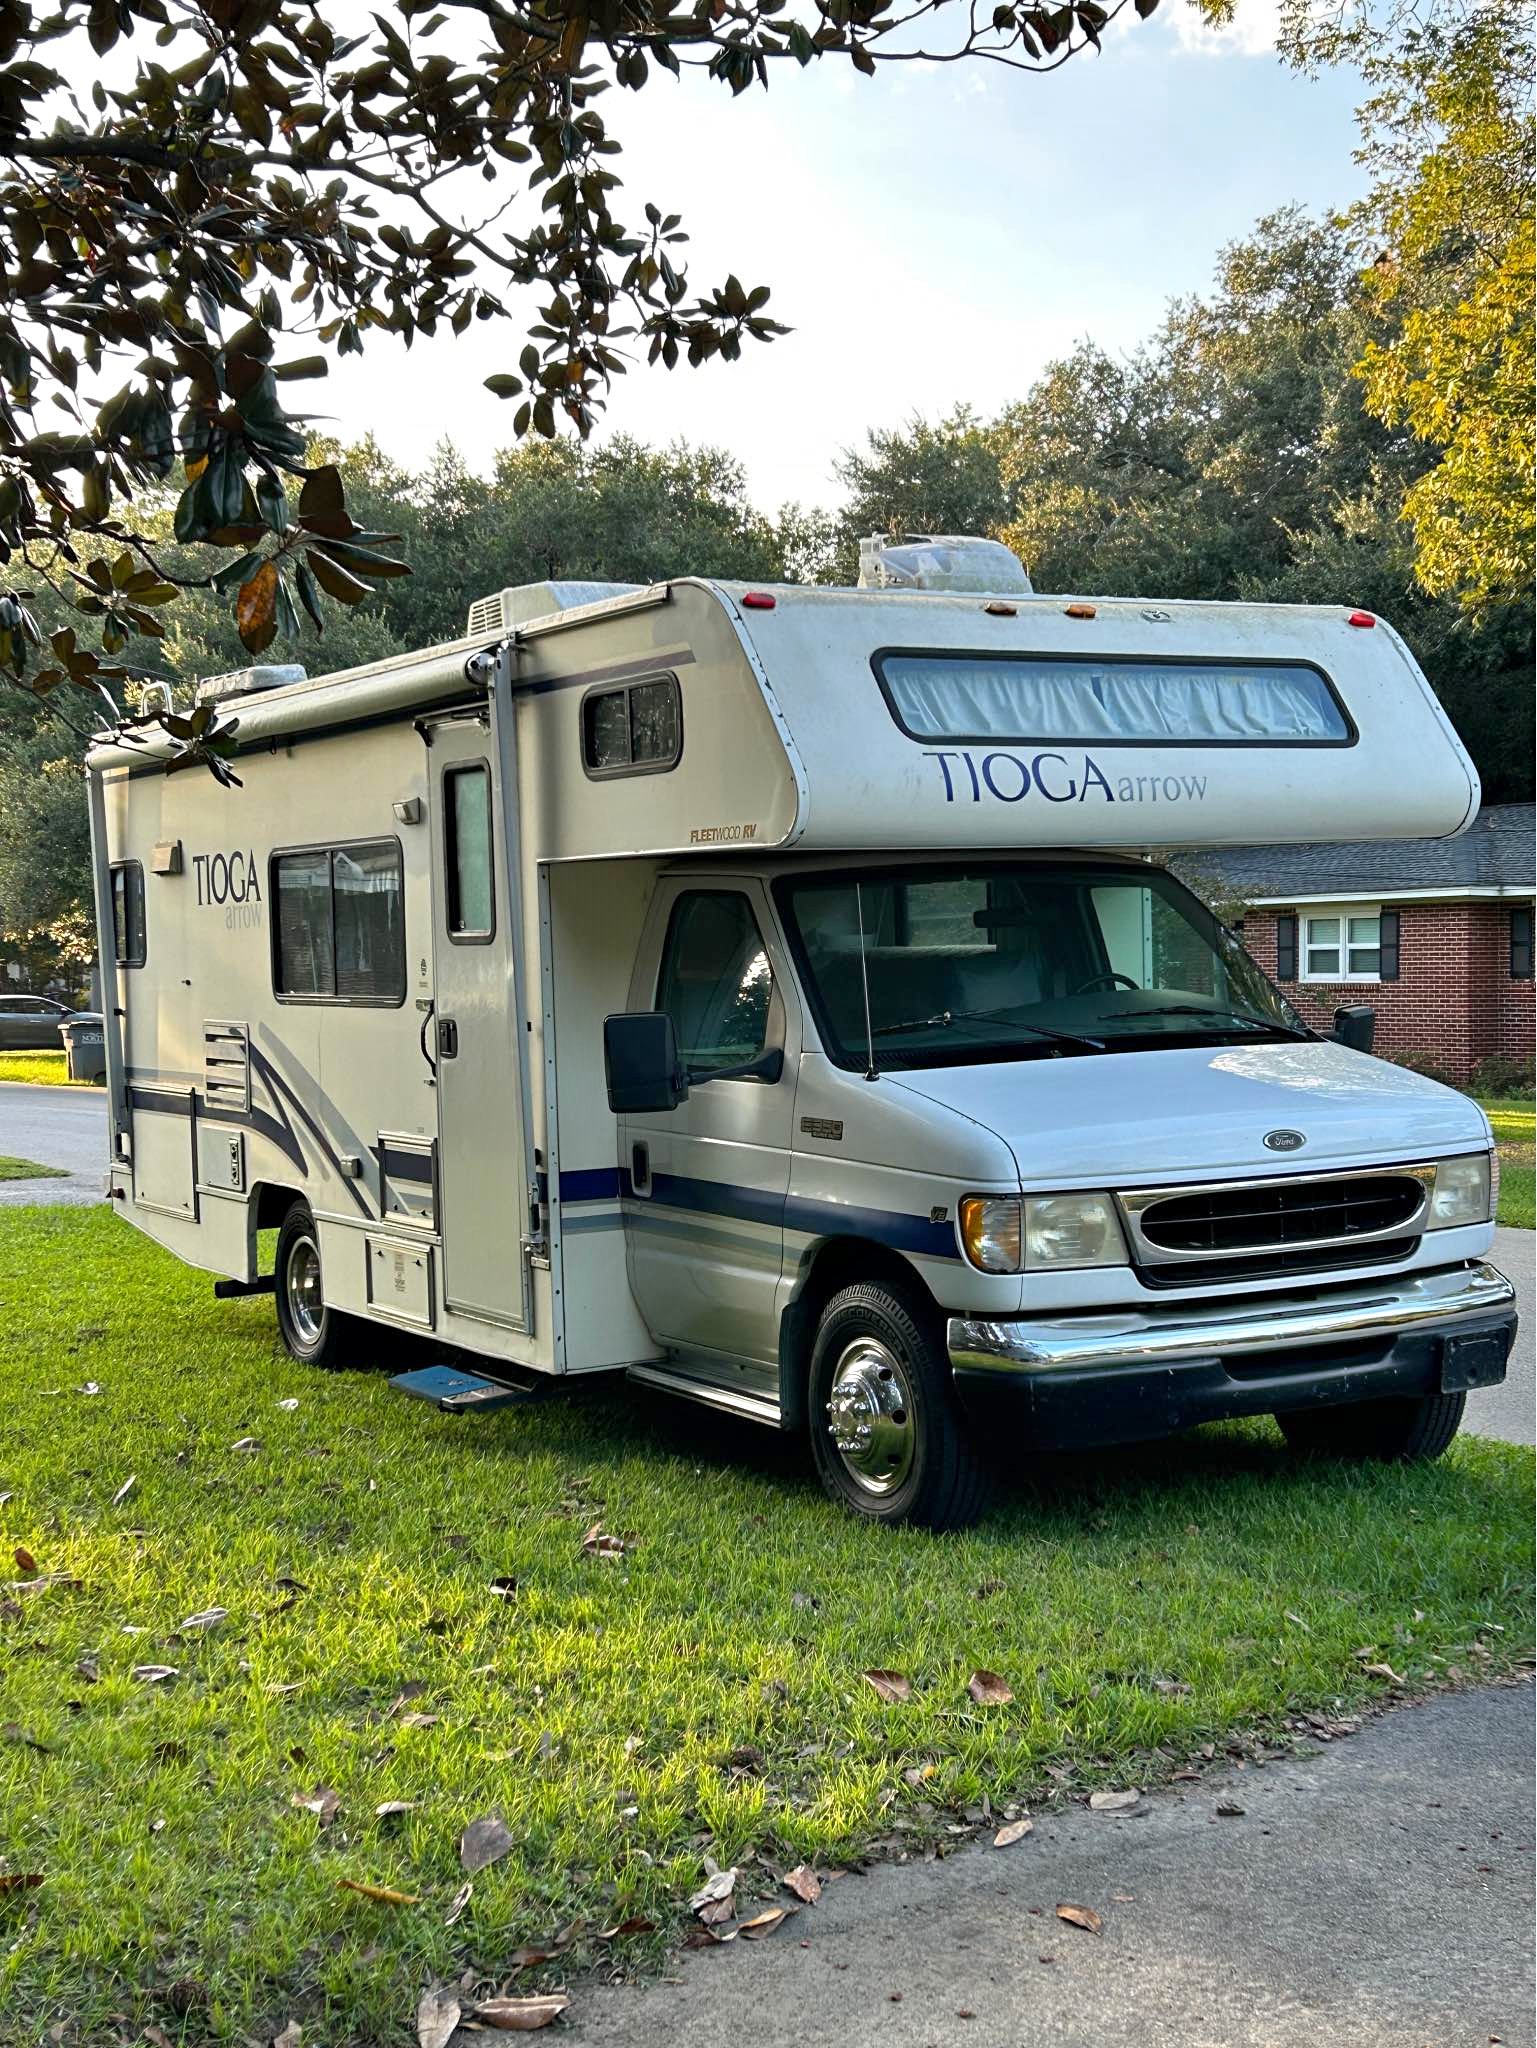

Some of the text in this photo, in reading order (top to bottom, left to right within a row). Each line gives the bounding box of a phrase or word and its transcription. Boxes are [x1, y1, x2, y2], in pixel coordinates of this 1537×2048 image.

[922, 751, 1209, 802] TIOGA arrow
[690, 823, 757, 843] FLEETWOOD RV
[192, 849, 262, 906] TIOGA
[224, 903, 263, 929] arrow
